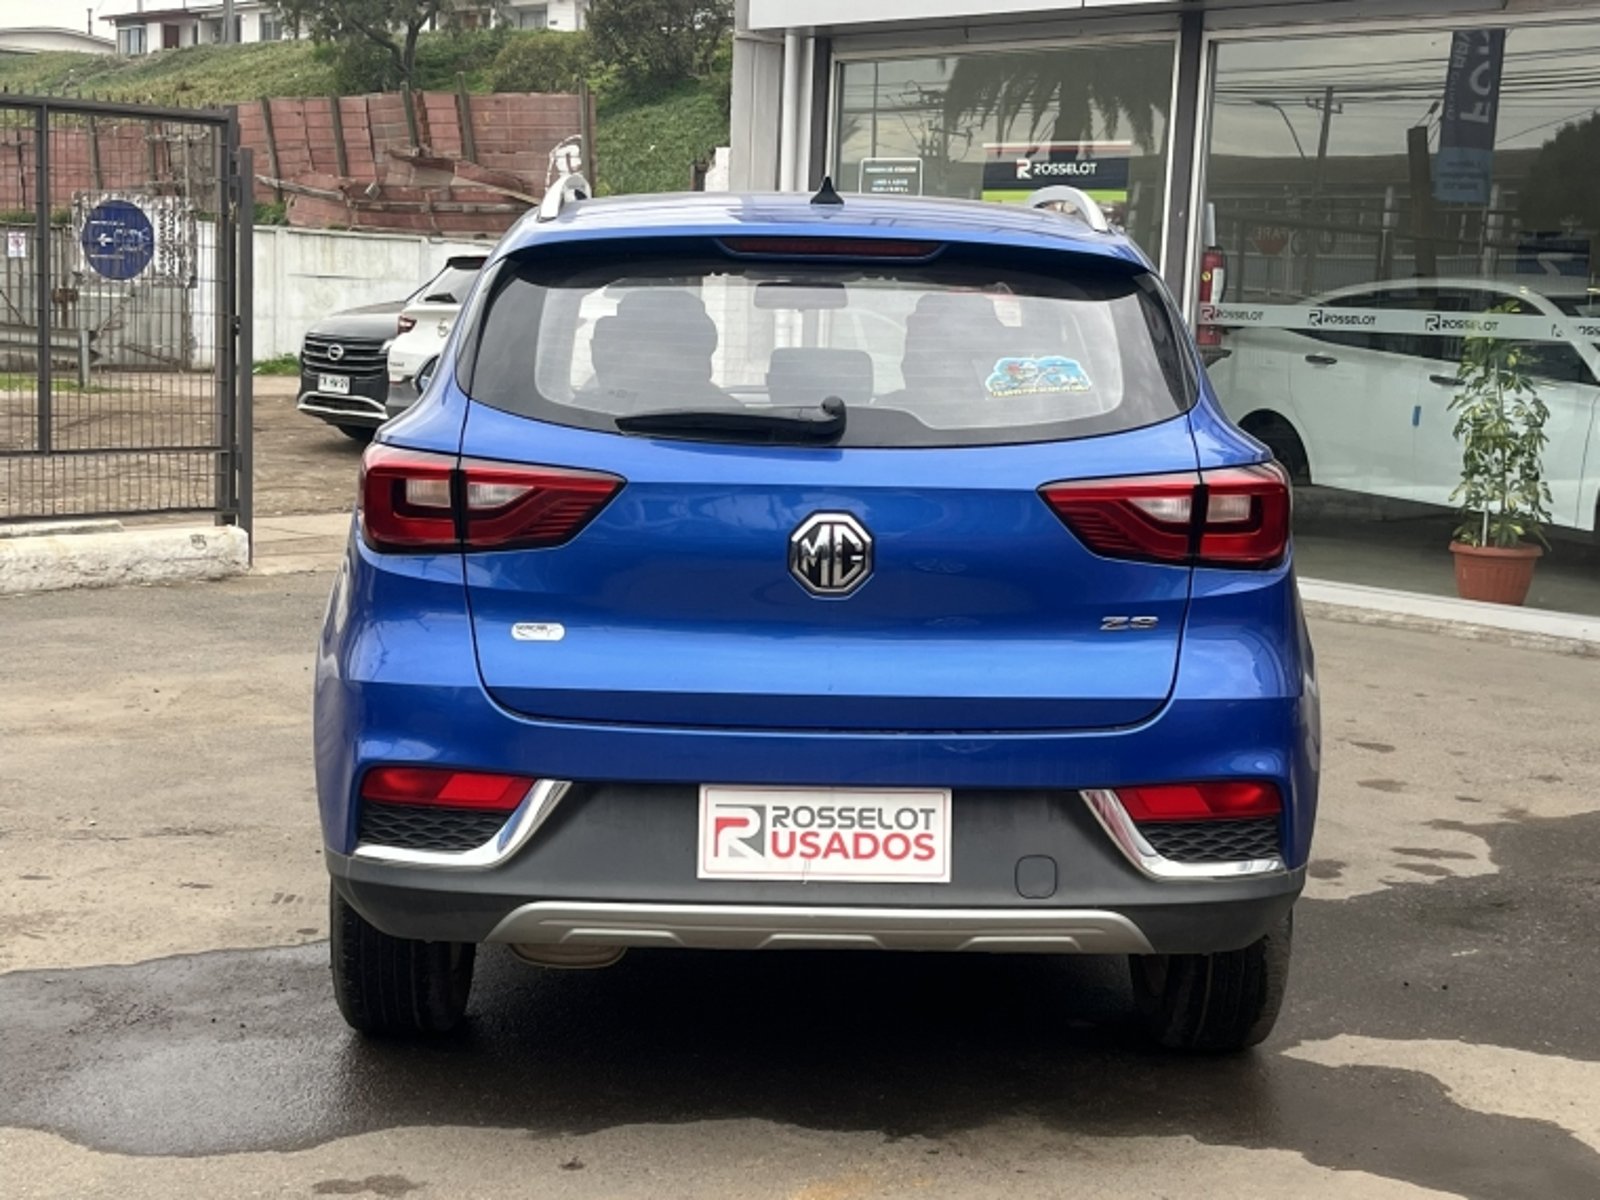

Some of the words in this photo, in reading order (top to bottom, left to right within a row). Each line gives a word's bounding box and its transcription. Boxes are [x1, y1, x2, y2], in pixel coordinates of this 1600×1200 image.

[1033, 163, 1097, 175] ROSSELOT
[1215, 308, 1264, 320] ROSSELOT
[1323, 314, 1376, 325] ROSSELOT
[800, 524, 864, 586] MG
[1099, 615, 1159, 630] ZS
[771, 805, 936, 830] ROSSELOT
[770, 831, 936, 862] USADOS
